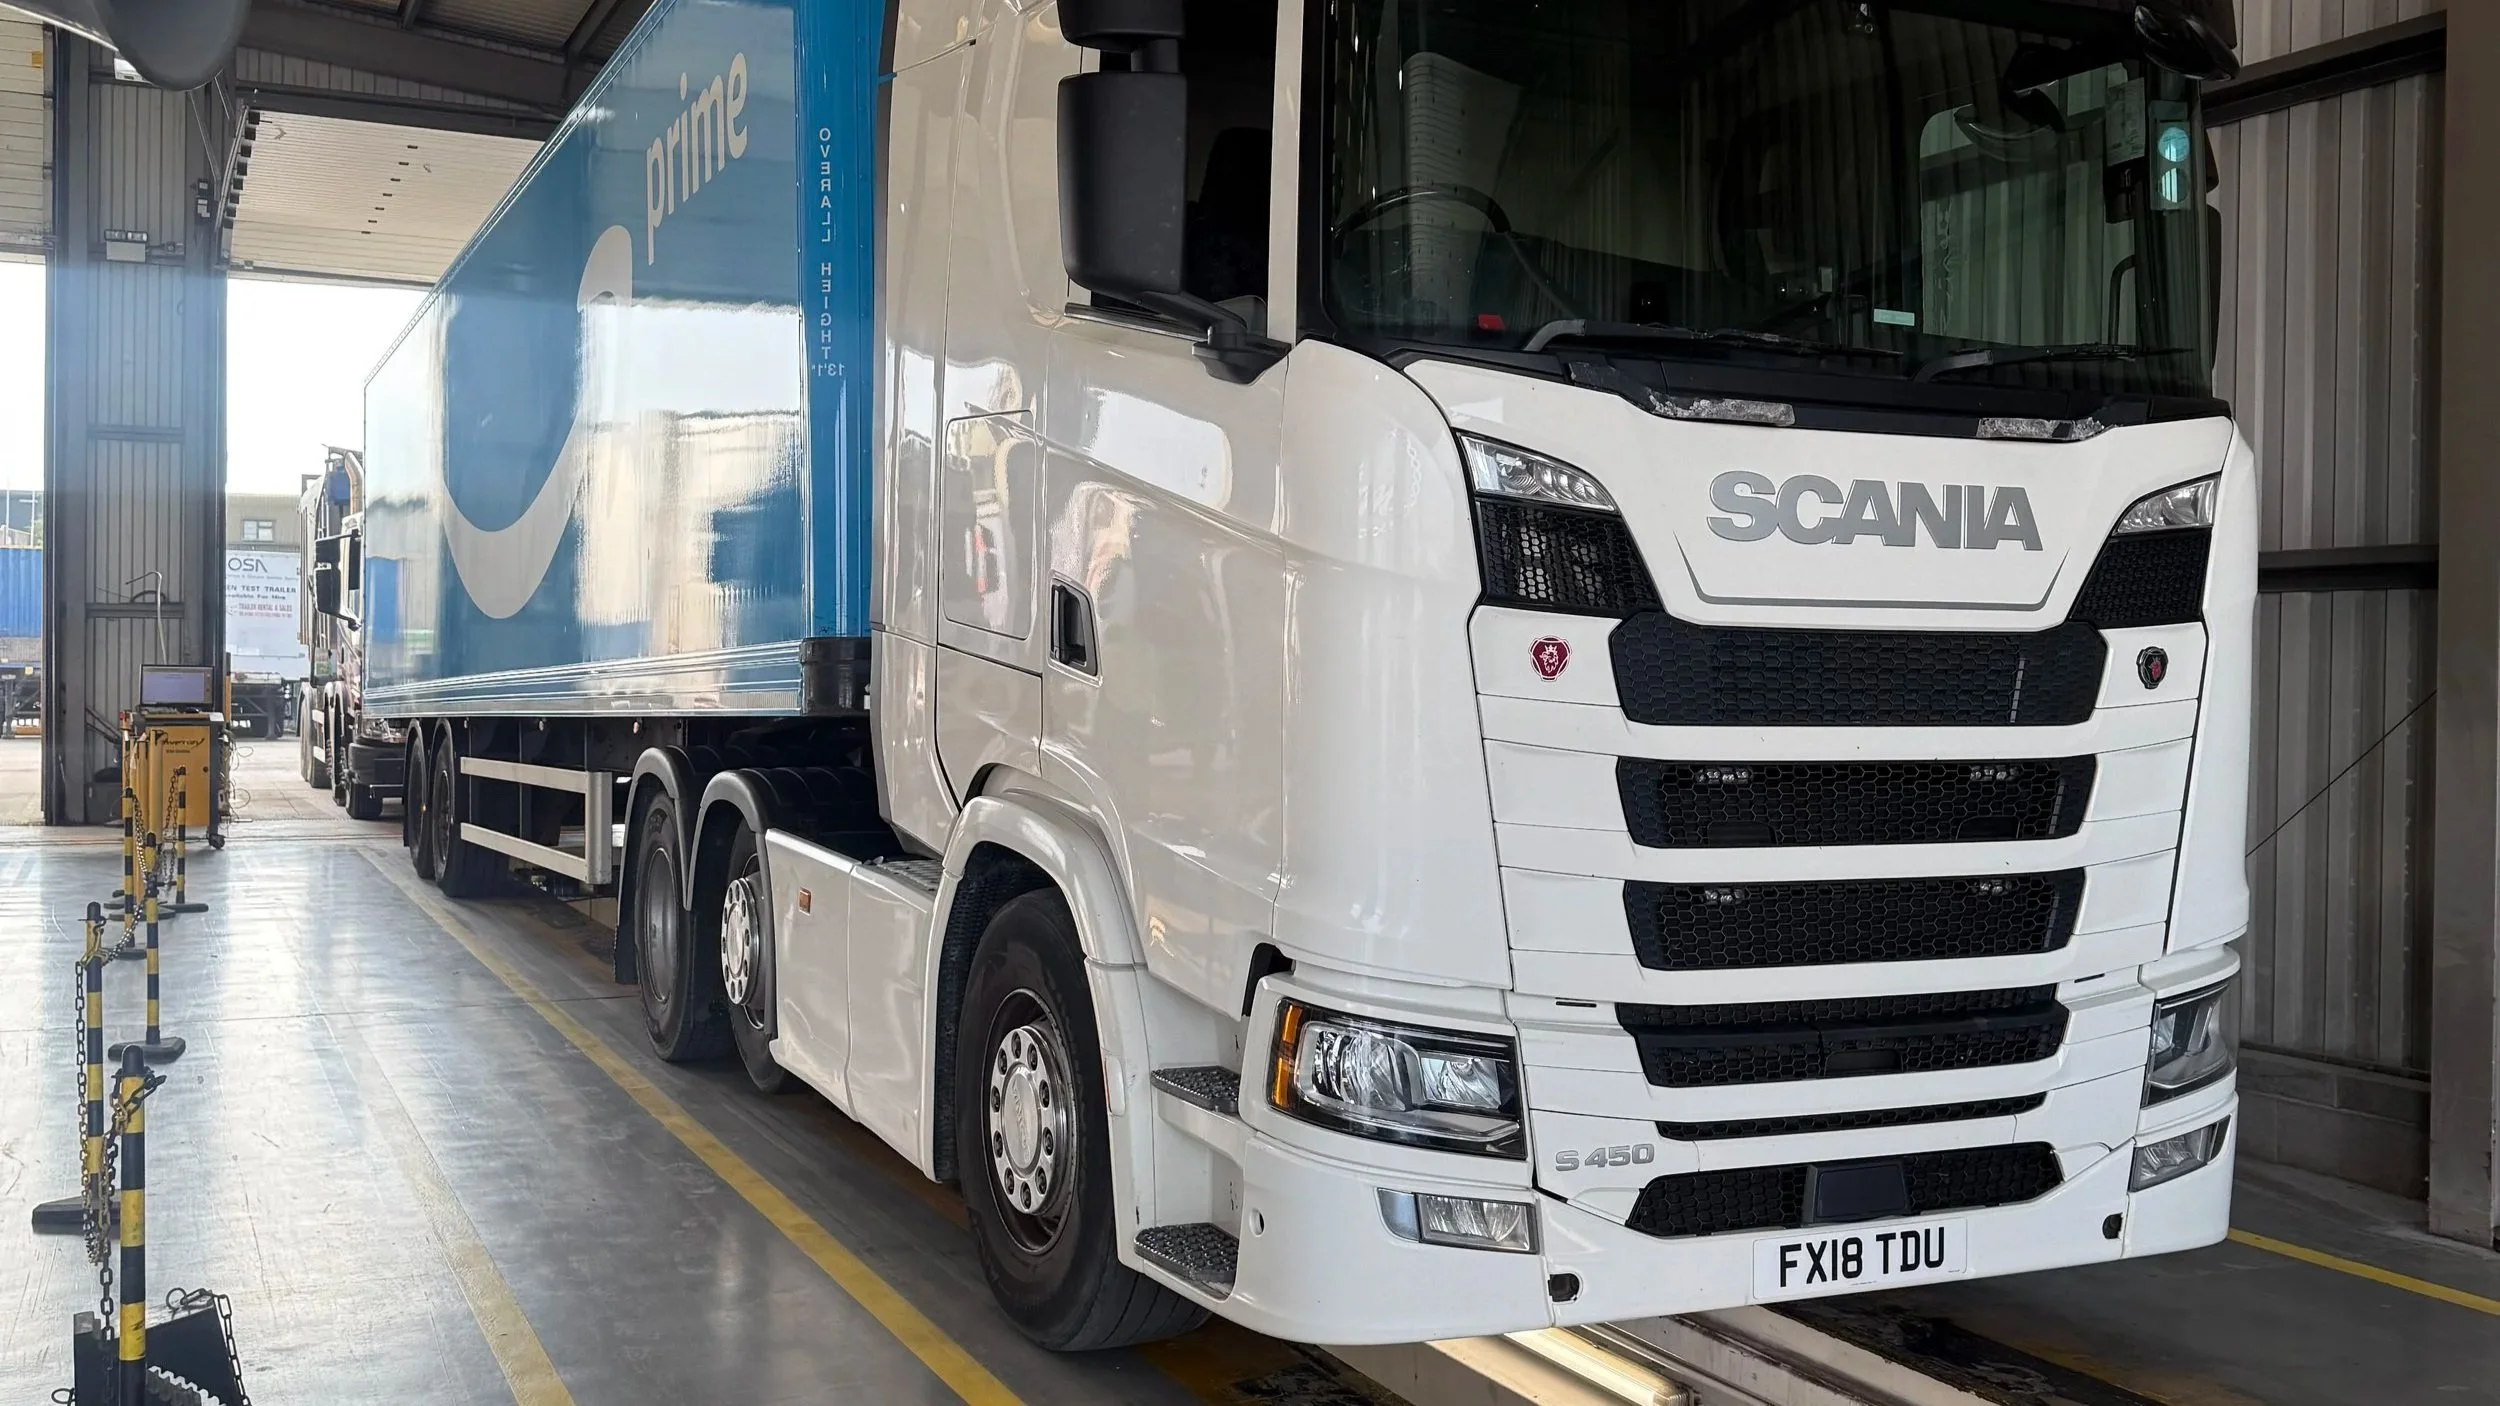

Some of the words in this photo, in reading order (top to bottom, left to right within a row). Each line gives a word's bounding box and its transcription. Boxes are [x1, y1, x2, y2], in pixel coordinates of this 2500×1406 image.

[646, 52, 748, 266] prime
[1706, 470, 2043, 551] SCANIA
[1555, 1150, 1580, 1172] S
[1584, 1143, 1655, 1168] 450
[1779, 1236, 1863, 1288] FX18
[1876, 1226, 1945, 1275] TDU
